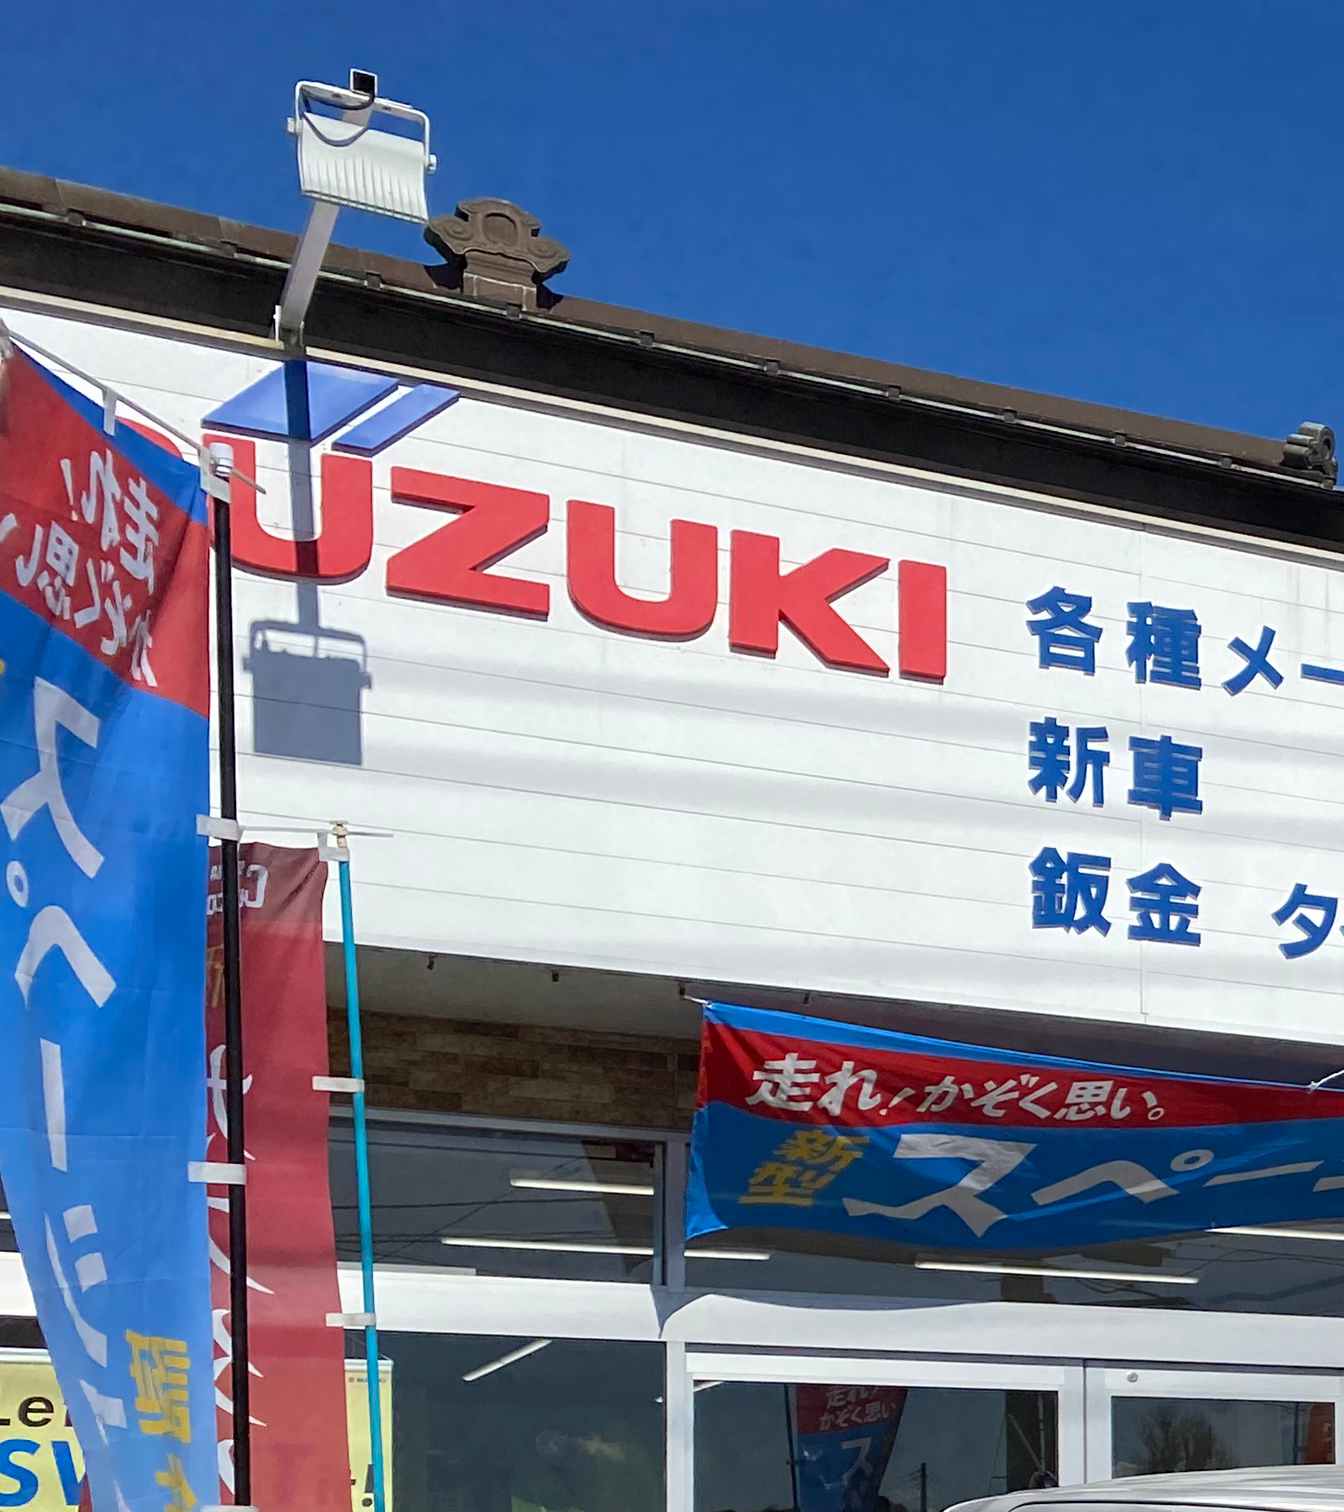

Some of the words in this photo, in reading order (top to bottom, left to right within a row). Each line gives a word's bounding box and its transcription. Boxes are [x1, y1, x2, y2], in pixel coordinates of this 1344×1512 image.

[114, 416, 948, 685] UZUKI
[1027, 716, 1204, 822] 新車
[1029, 845, 1203, 947] 鈑金
[738, 1128, 870, 1208] 新型
